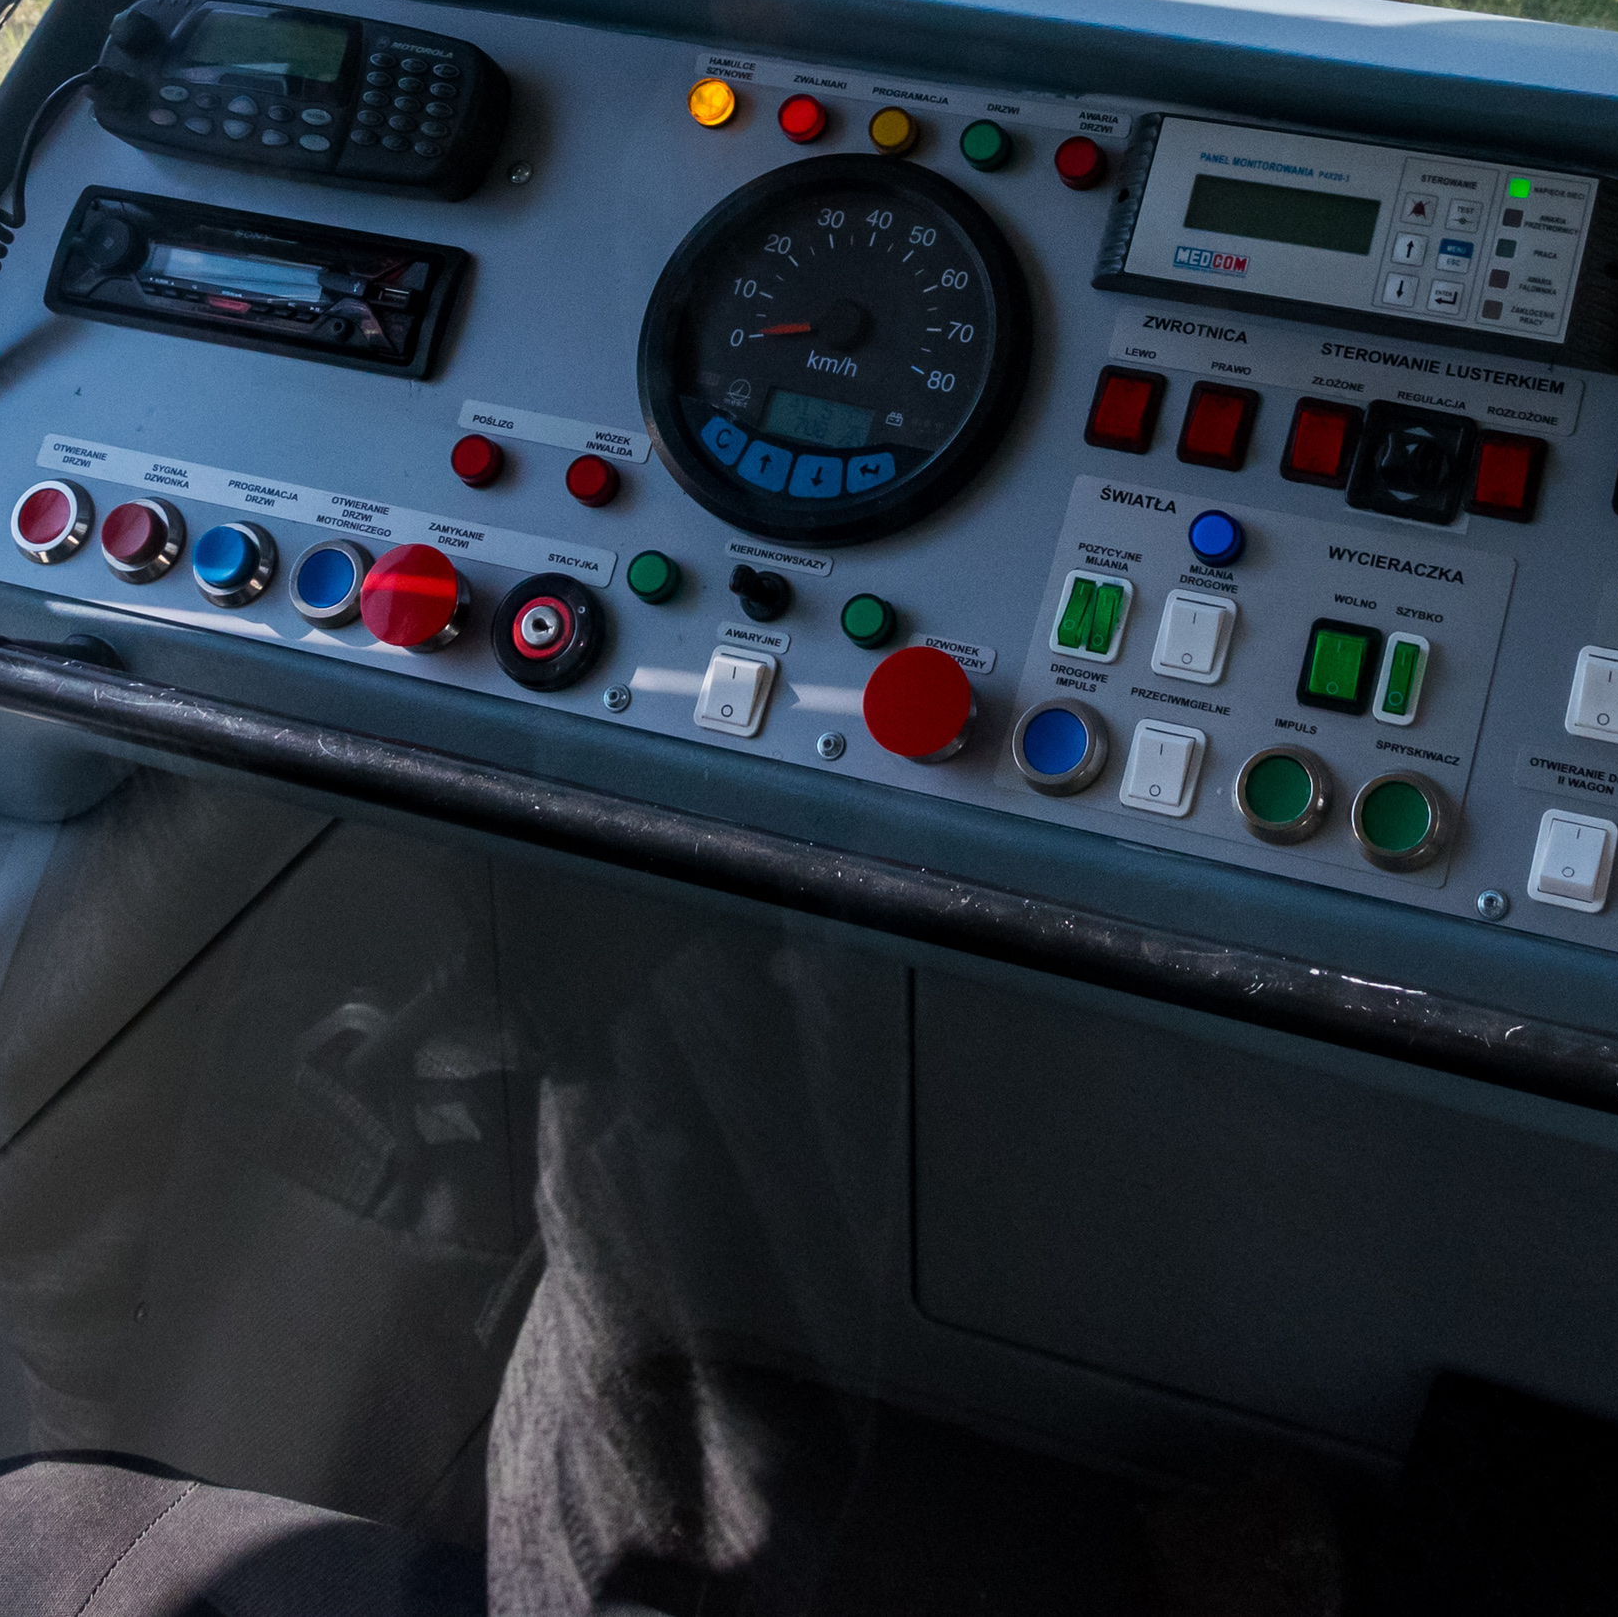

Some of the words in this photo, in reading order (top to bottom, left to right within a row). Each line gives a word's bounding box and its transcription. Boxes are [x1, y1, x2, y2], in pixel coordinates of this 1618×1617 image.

[391, 41, 454, 60] MOTOROLA
[706, 66, 753, 80] SZYNOWE
[709, 56, 756, 72] HAMULCE
[793, 74, 847, 90] ZWALNIAKI
[872, 86, 949, 106] PROGRAMACJA
[987, 102, 1020, 116] DRZWI
[1078, 111, 1120, 124] AWARIA
[1079, 121, 1113, 134] DRZWI
[1200, 152, 1229, 165] PANEL
[1232, 156, 1314, 176] MONITOROWANIA
[1421, 174, 1477, 190] STEROWANIE
[817, 208, 845, 229] 30
[865, 210, 893, 229] 40
[1457, 205, 1474, 215] TEST
[764, 233, 791, 255] 20
[908, 225, 937, 247] 50
[1175, 247, 1248, 272] MEDCOM
[1534, 250, 1557, 260] PRACA
[733, 278, 757, 299] 10
[941, 268, 969, 290] 60
[1142, 315, 1248, 345] ZWROTNICA
[1520, 317, 1543, 326] PRACY
[730, 329, 744, 347] 0
[948, 321, 974, 343] 70
[1124, 346, 1157, 360] LEWO
[806, 350, 858, 378] km/h
[1211, 361, 1252, 376] PRAWO
[1321, 342, 1441, 376] STEROWANIE
[1445, 361, 1565, 396] LUSTERKIEM
[927, 370, 955, 393] 80
[1311, 375, 1365, 393] ZŁOŻONE
[1397, 390, 1467, 411] REGULACJA
[473, 412, 515, 431] POŚLIZG
[1486, 404, 1559, 427] ROZŁOŻONE
[594, 430, 632, 447] WÓZEK
[53, 442, 108, 463] OTWIERANIE
[585, 440, 634, 458] INWALIDA
[62, 454, 92, 469] DRZWI
[151, 463, 189, 480] SYGNAŁ
[143, 471, 190, 490] DZWONKA
[227, 479, 299, 503] PROGRAMACJA
[245, 493, 276, 509] DRZWI
[1099, 483, 1177, 516] ŚWIATŁA
[331, 495, 390, 517] OTWIERANIE
[341, 508, 373, 523] DRZWI
[316, 514, 392, 539] MOTORNICZEGO
[428, 521, 486, 543] ZAMYKANIE
[437, 535, 470, 551] DRZWI
[1077, 541, 1143, 564] POZYCYJNE
[547, 552, 600, 573] STACYJKA
[729, 542, 828, 572] KIERUNKOWSKAZY
[1085, 554, 1130, 573] MIJANIA
[1328, 545, 1466, 587] WYCIERACZKA
[1189, 564, 1235, 583] MIJANIA
[1178, 574, 1239, 596] DROGOWE
[1333, 593, 1378, 611] WOLNO
[1395, 606, 1444, 625] SZYBKO
[724, 628, 783, 649] AWARYJNE
[925, 637, 980, 658] DZWONEK
[1050, 662, 1110, 685] DROGOWE
[1055, 676, 1097, 694] IMPULS
[1130, 686, 1231, 717] PRZECIWMGIELNE
[1274, 717, 1318, 736] IMPULS
[1375, 739, 1461, 768] SPRYSKIWACZ
[1529, 756, 1608, 784] OTWIERANIE
[1558, 775, 1565, 785] II
[1567, 777, 1615, 797] WAGON
